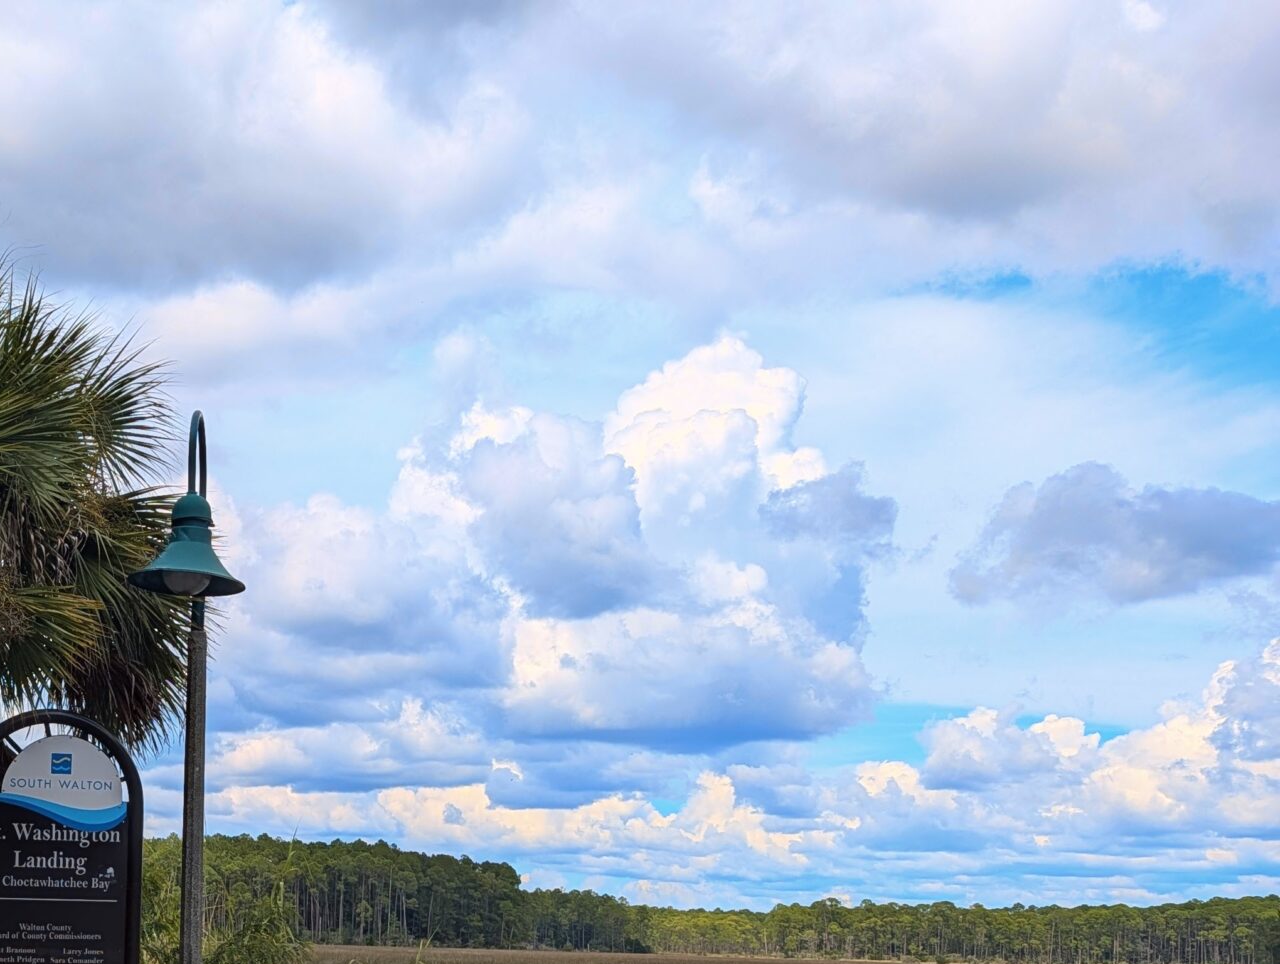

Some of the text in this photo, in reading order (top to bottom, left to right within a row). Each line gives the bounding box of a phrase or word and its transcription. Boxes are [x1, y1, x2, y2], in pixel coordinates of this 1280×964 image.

[10, 778, 113, 790] SOUTH WALTON
[12, 822, 121, 848] Washington
[13, 850, 88, 875] Landing
[2, 876, 88, 888] Choctawhatchee
[91, 878, 111, 892] Bay
[19, 923, 72, 932] Walton County
[11, 931, 19, 939] of
[22, 931, 47, 941] County
[48, 932, 102, 940] Commissioners
[63, 948, 82, 956] Larry
[16, 955, 45, 964] Pridgen
